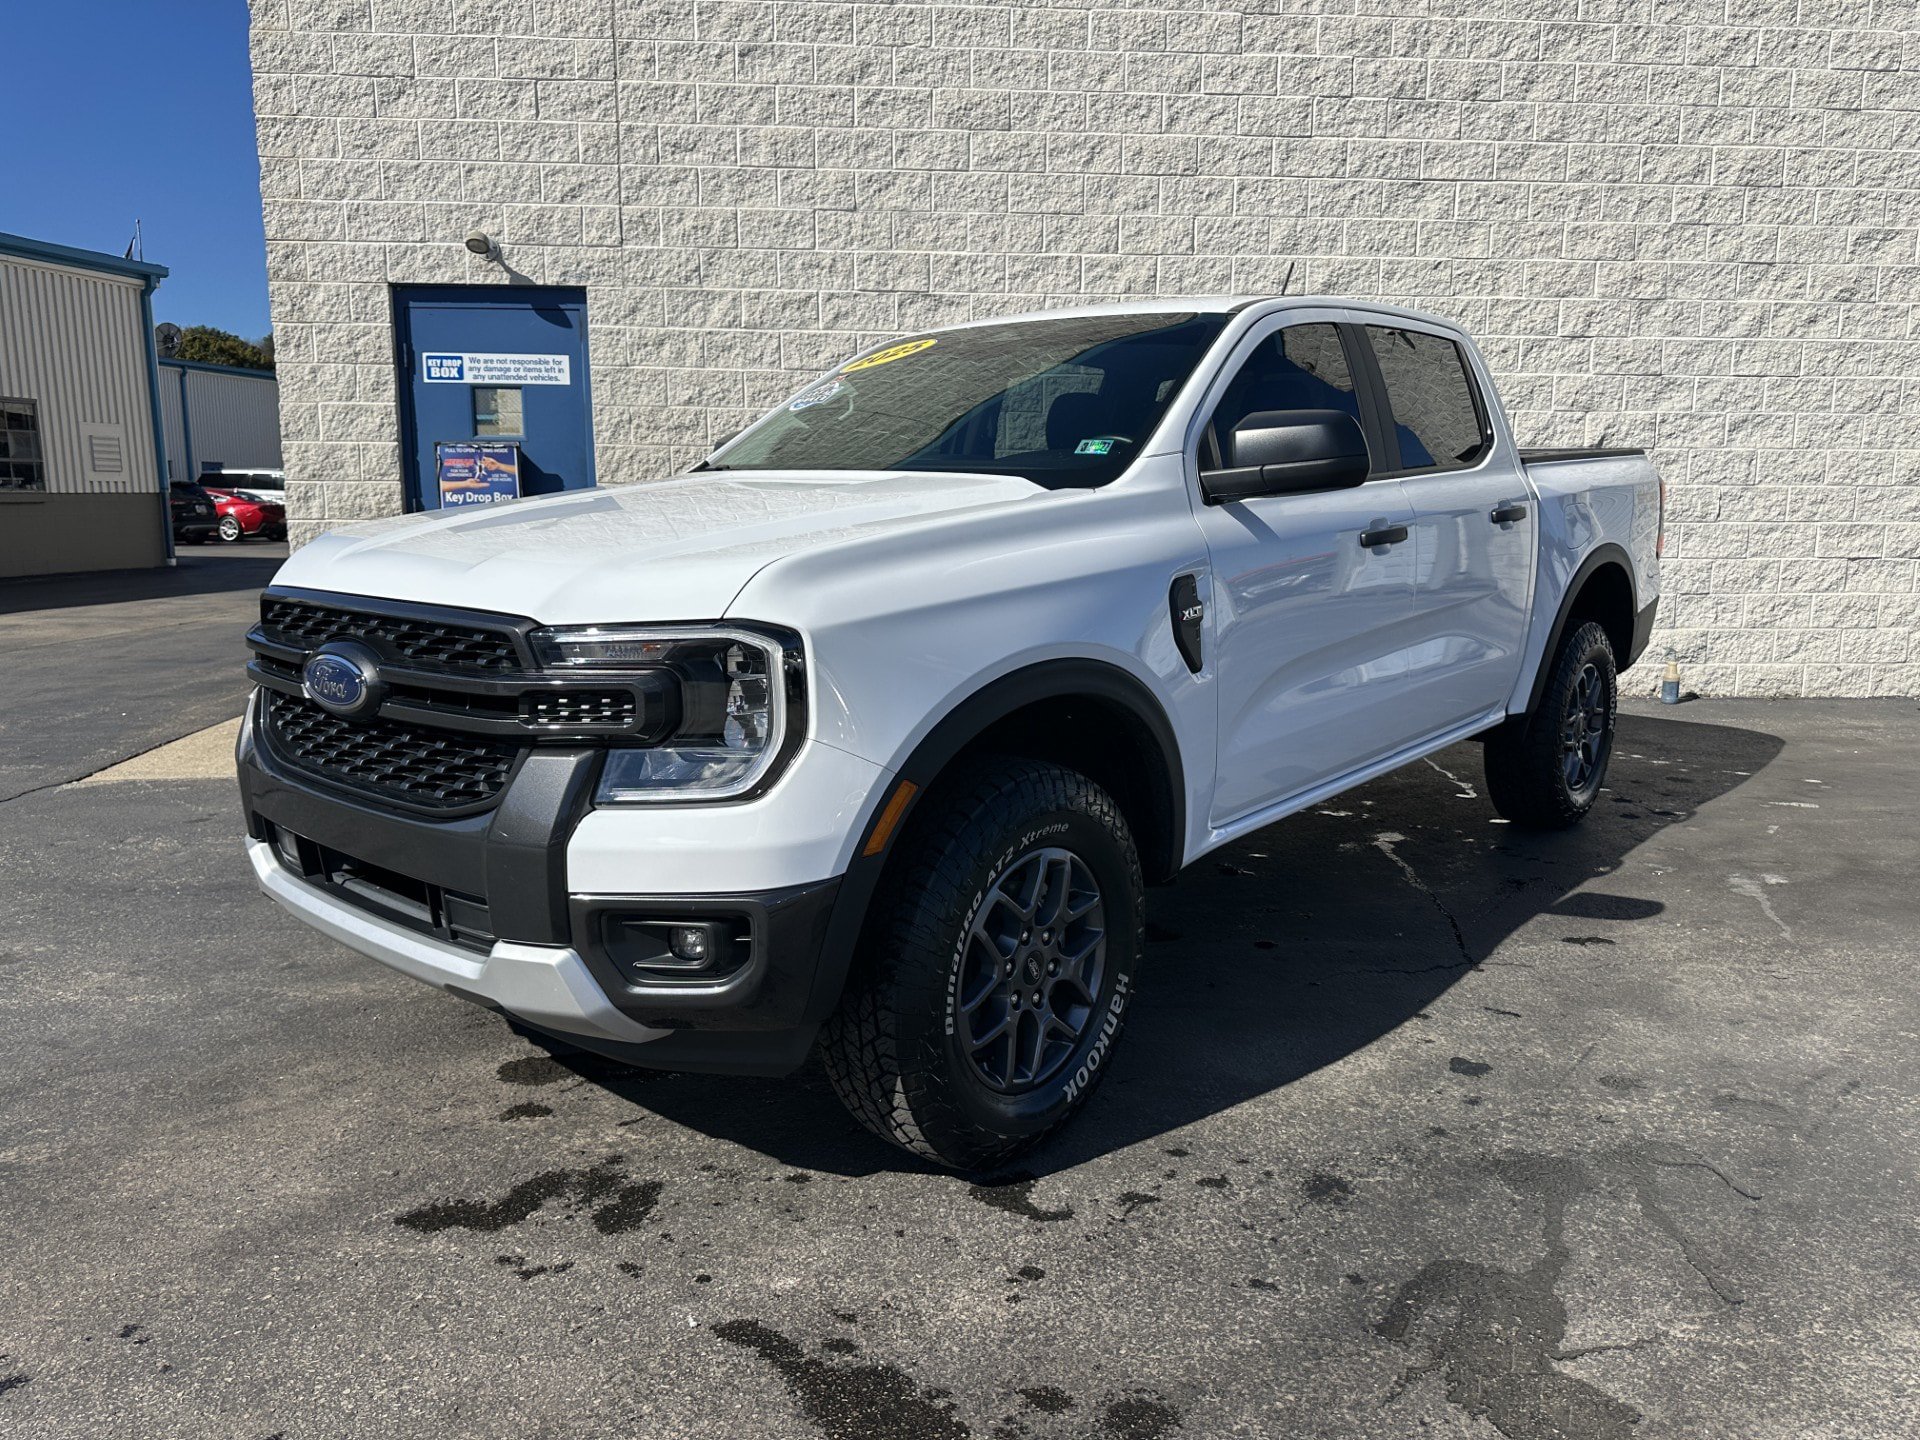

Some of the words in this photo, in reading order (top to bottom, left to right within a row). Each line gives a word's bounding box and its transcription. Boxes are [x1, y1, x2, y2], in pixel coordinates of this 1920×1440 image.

[428, 359, 441, 367] KEY
[442, 359, 462, 367] DROP
[510, 358, 550, 366] responsible
[431, 367, 459, 378] BOX
[483, 365, 511, 374] damage
[445, 491, 464, 504] Key
[466, 491, 492, 503] Drop
[1182, 605, 1202, 620] XLT
[313, 665, 348, 698] Ford
[987, 846, 1014, 887] AT2
[1019, 822, 1069, 850] Xtreme
